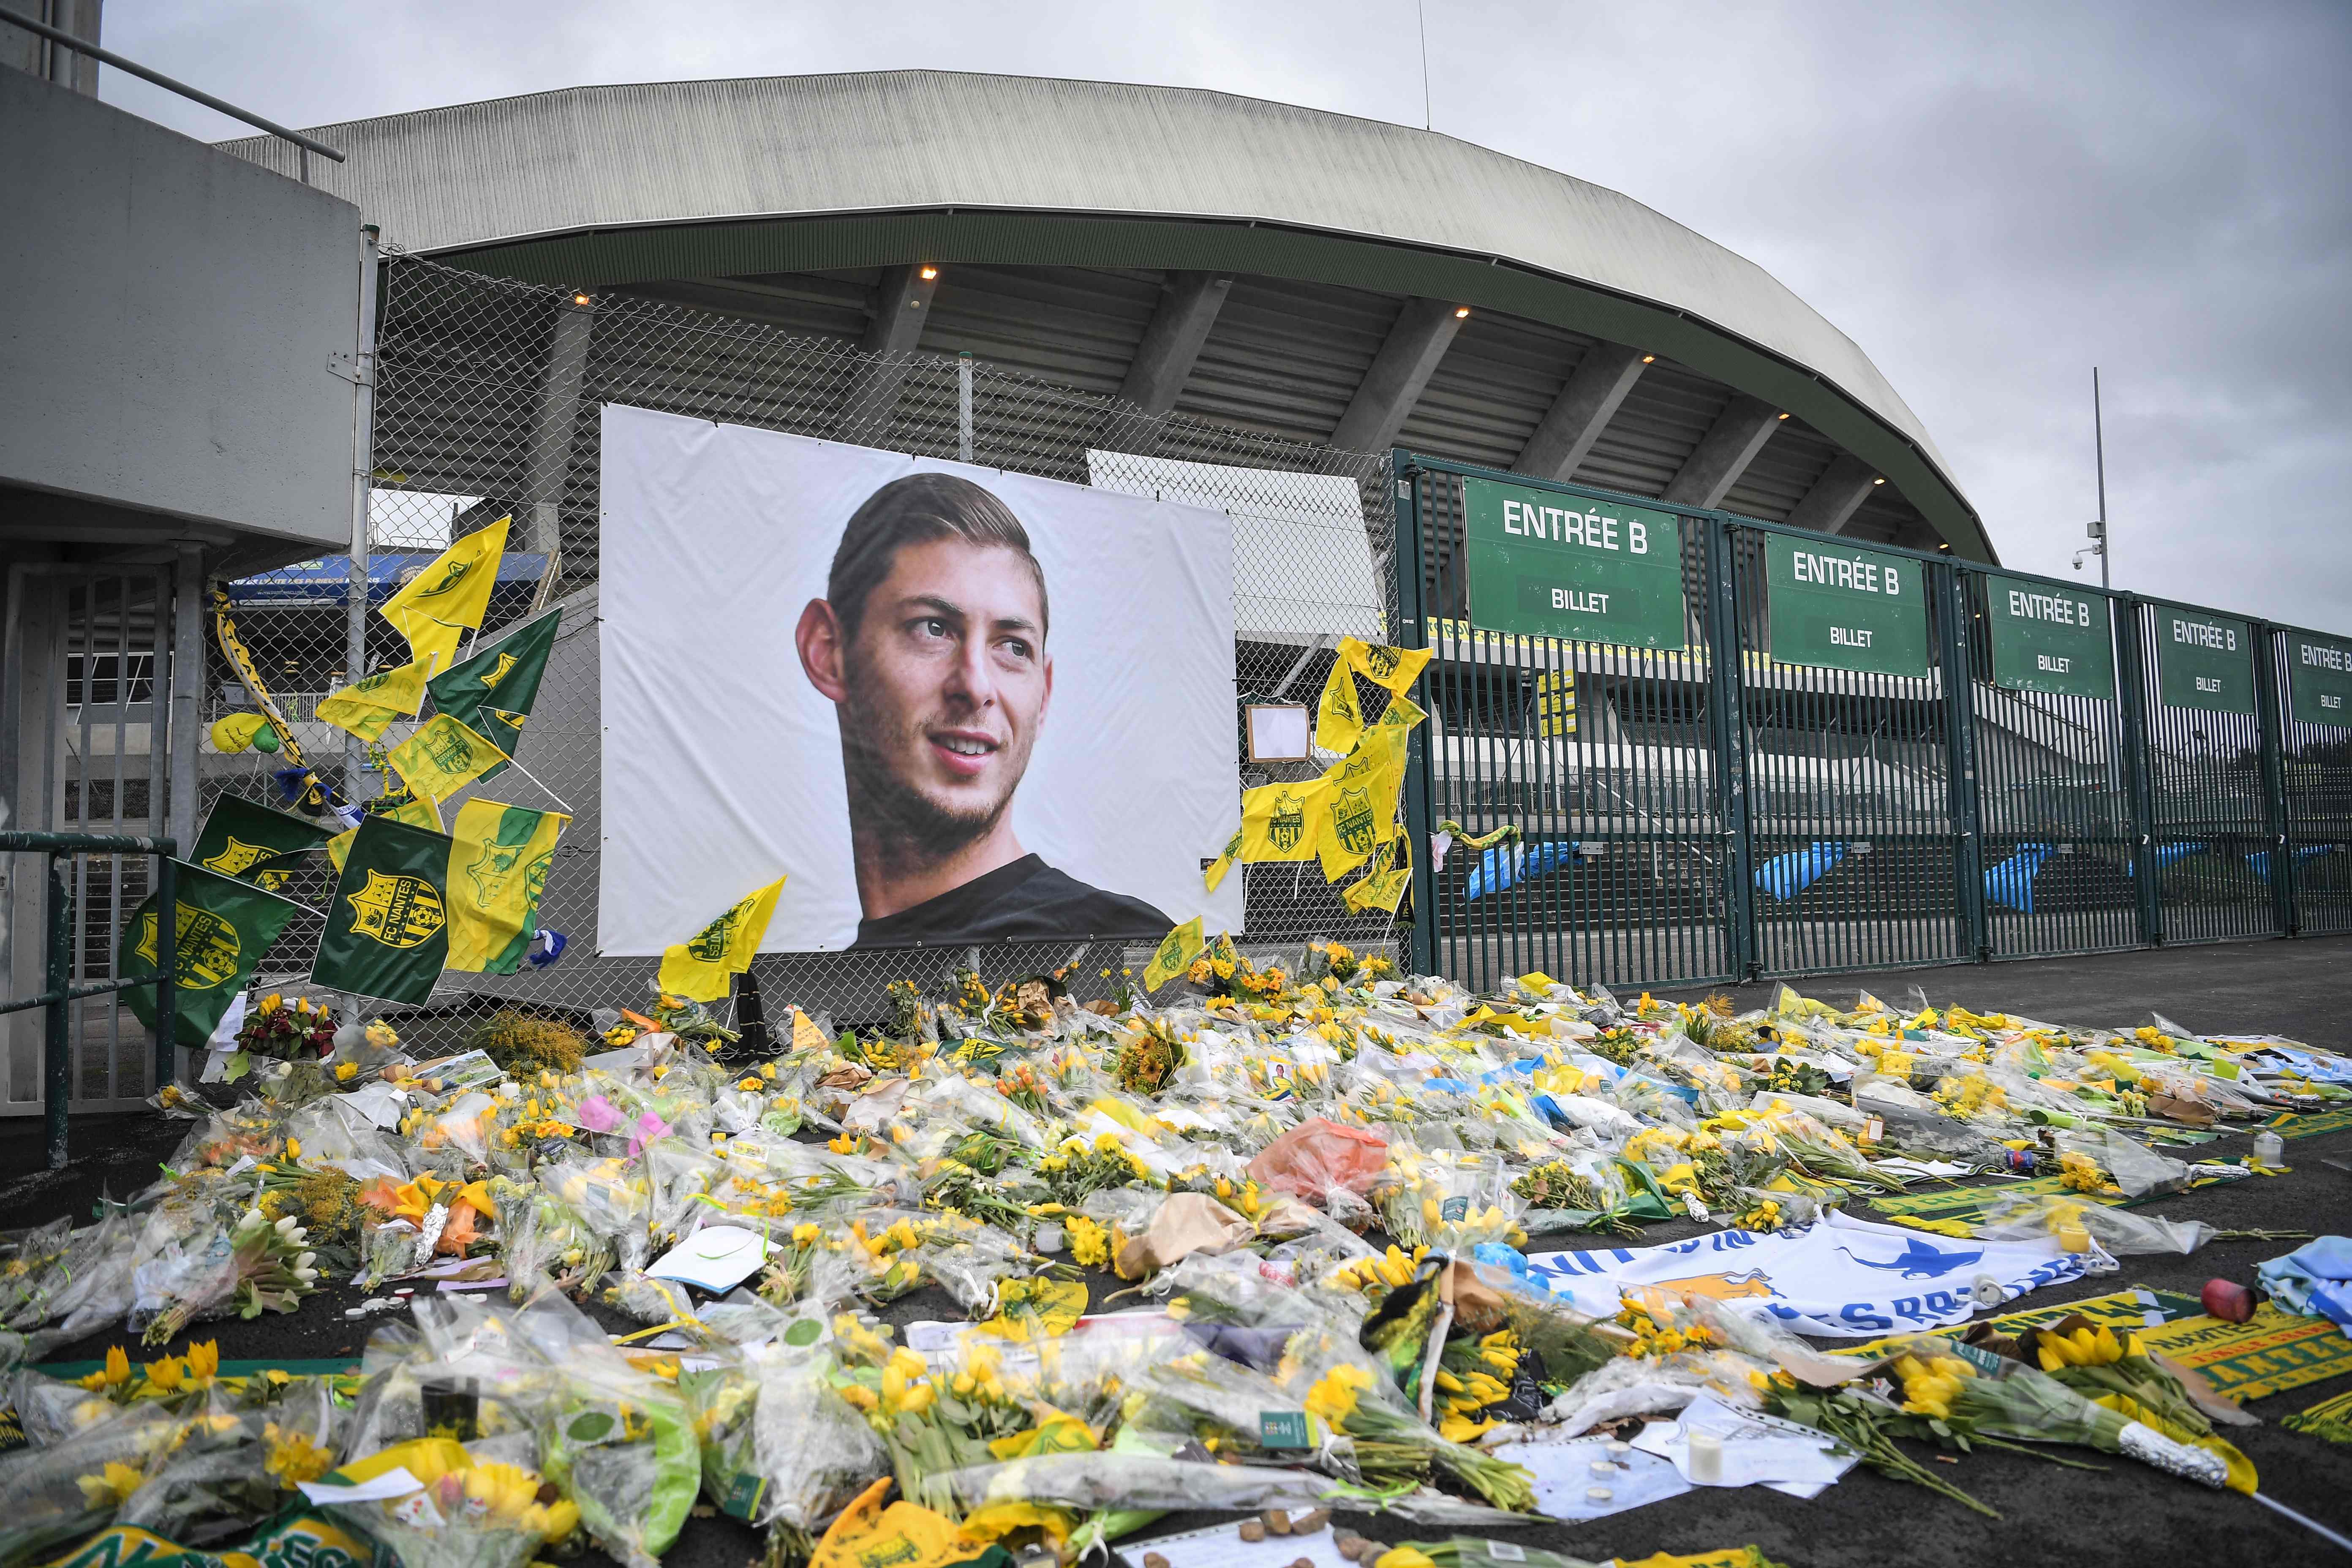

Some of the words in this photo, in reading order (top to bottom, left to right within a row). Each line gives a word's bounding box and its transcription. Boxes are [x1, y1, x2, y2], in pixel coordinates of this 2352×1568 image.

[1503, 500, 1619, 550] ENTRÉE
[1629, 521, 1648, 554] B
[1793, 551, 1878, 593] ENTRÉE
[1885, 567, 1899, 595] B
[1551, 588, 1609, 614] BILLET
[2009, 590, 2074, 625] ENTRÉE
[2078, 602, 2090, 627] B
[1830, 626, 1873, 648] BILLET
[2172, 619, 2224, 649] ENTRÉE
[2226, 629, 2236, 651] B
[2038, 655, 2070, 673] BILLET
[2301, 644, 2342, 671] ENTRÉE
[2345, 653, 2352, 672] B
[2196, 676, 2221, 692] BILLET
[2321, 694, 2341, 709] BILLET
[1337, 824, 1346, 834] FC
[1346, 811, 1372, 830] NANTES
[389, 880, 412, 924] NANTES
[177, 915, 212, 960] NANTES
[384, 926, 397, 941] FC
